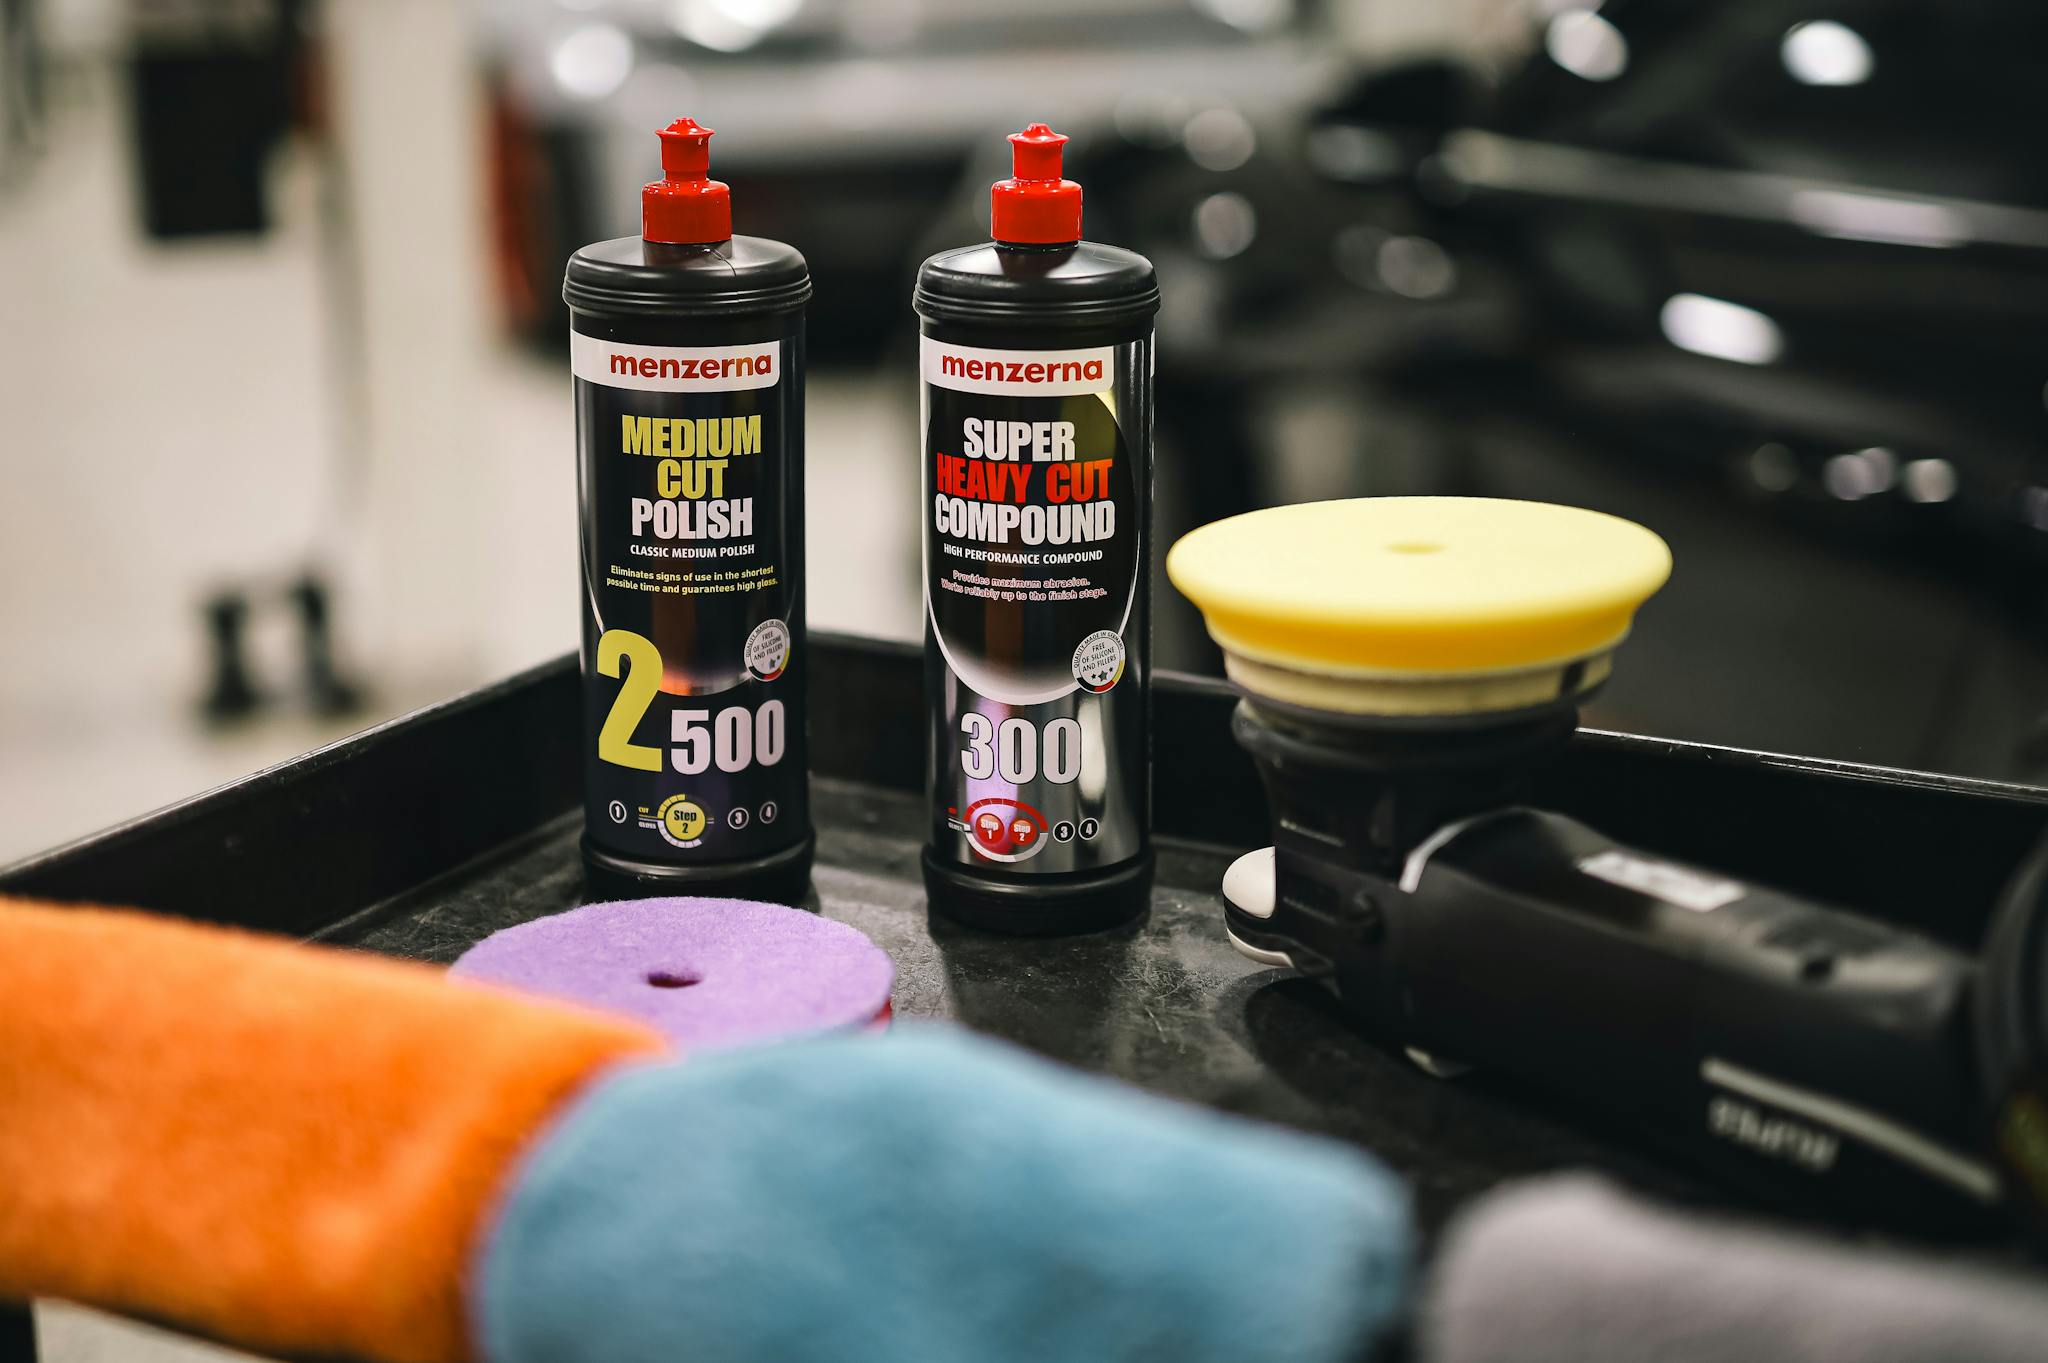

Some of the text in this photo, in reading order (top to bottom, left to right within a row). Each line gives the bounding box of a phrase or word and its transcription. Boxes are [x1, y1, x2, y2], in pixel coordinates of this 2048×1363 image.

[610, 354, 771, 379] menzerna
[942, 355, 1102, 383] menzerna
[622, 414, 761, 457] MEDIUM
[963, 417, 1075, 462] SUPER
[657, 458, 728, 499] CUT
[936, 452, 1113, 503] HEAVY CUT
[631, 497, 752, 539] POLISH
[935, 493, 1116, 546] COMPOUND
[630, 544, 755, 558] CLASSIC MEDIUM POLISH
[943, 543, 1103, 565] HIGH PERFORMANCE COMPOUND
[610, 564, 654, 580] Eliminates
[656, 572, 681, 582] signs
[683, 573, 693, 581] of
[714, 572, 723, 580] in
[725, 571, 740, 580] the
[741, 565, 774, 579] shortest
[952, 569, 1091, 589] Provides maximum abrasion.
[606, 577, 778, 595] possible time and guarantees high gloss.
[940, 577, 1108, 602] Works reliably up to the finish stage.
[1092, 641, 1105, 653] FREE
[1081, 656, 1091, 664] OF
[1082, 662, 1096, 673] AND
[960, 712, 1082, 785] 300
[614, 805, 621, 818] 1
[673, 809, 697, 822] Step
[734, 811, 743, 825] 3
[764, 805, 772, 818] 4
[682, 822, 689, 834] 2
[980, 818, 999, 831] Step
[1013, 823, 1031, 834] Step
[1085, 822, 1093, 836] 4
[987, 830, 993, 840] 1
[1018, 833, 1026, 842] 2
[1060, 825, 1069, 839] 3
